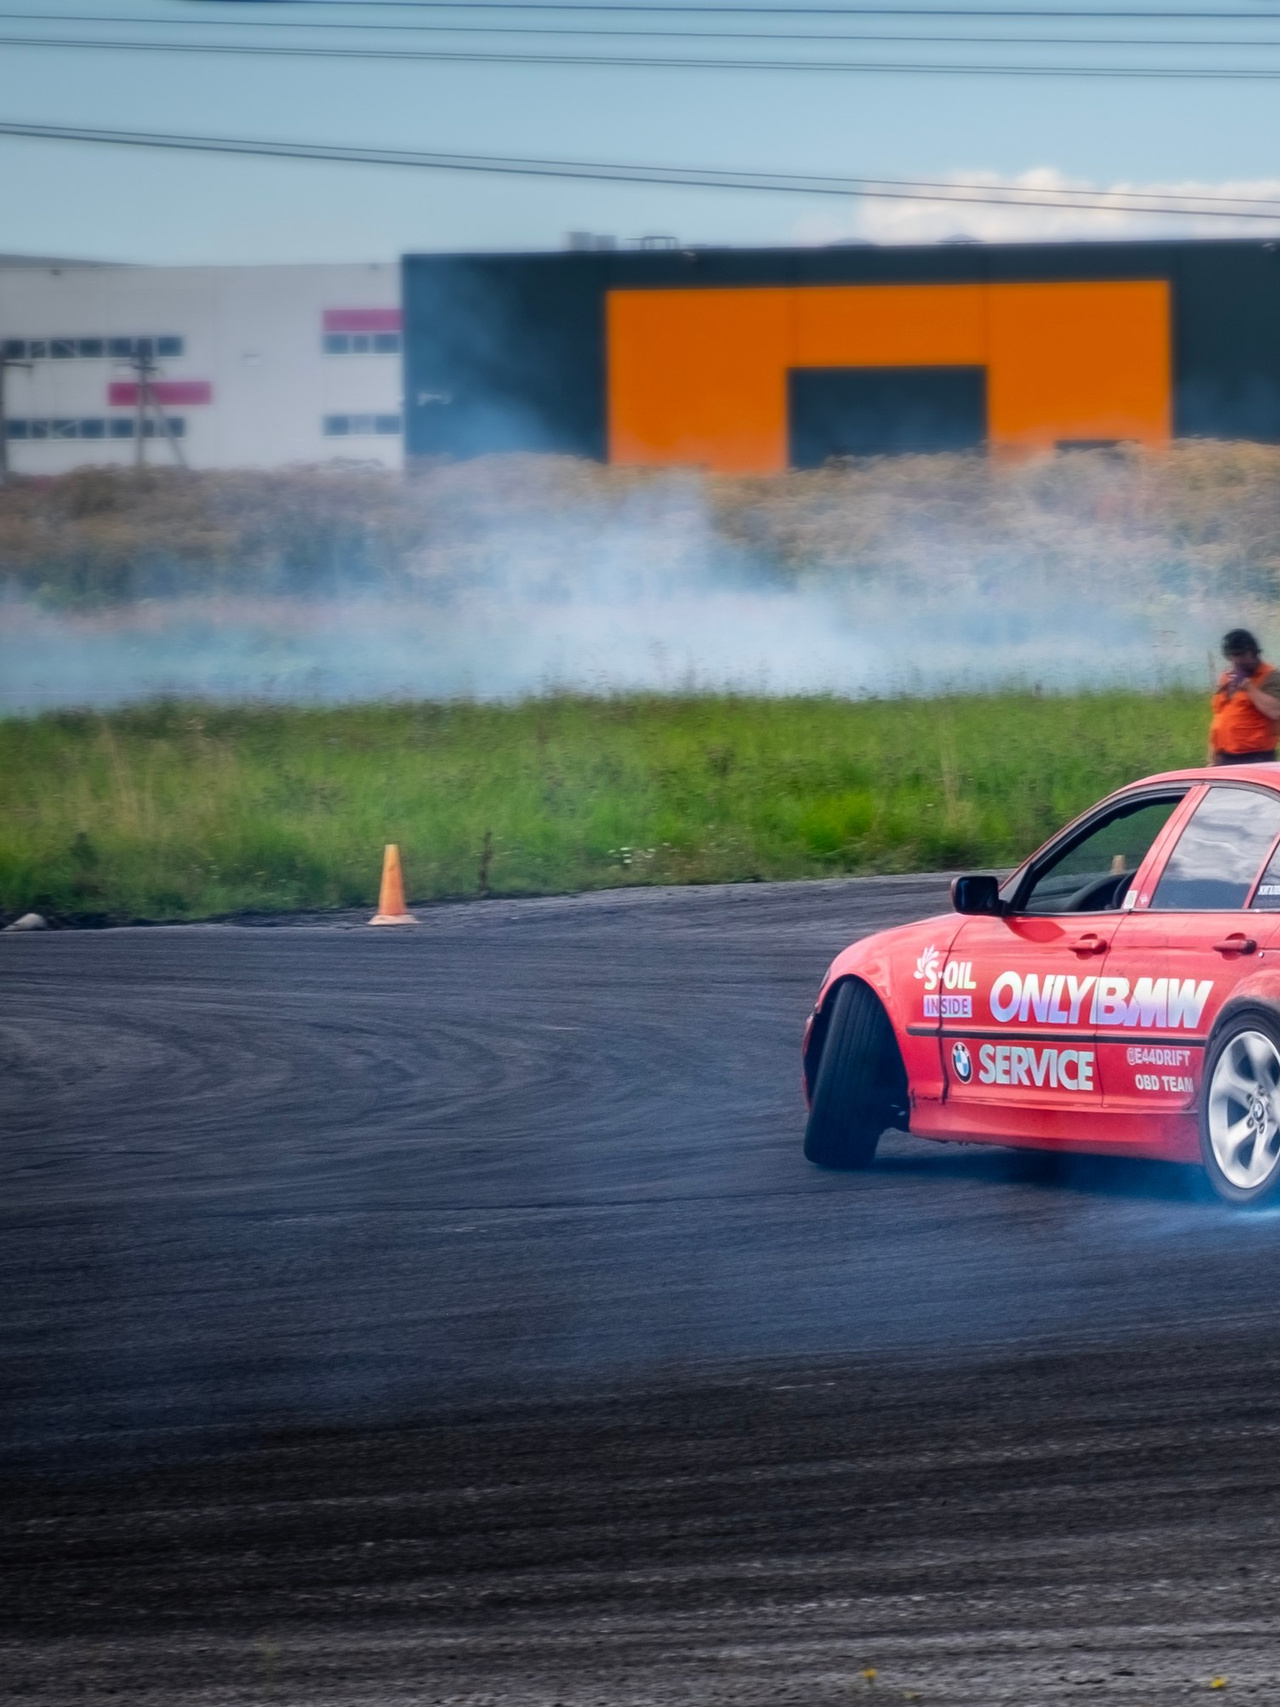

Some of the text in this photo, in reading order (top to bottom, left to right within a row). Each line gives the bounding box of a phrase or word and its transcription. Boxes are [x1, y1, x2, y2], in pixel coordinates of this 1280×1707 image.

[926, 997, 969, 1015] INSIDE
[990, 970, 1214, 1028] ONLYBMW
[1126, 1048, 1190, 1066] @E44DRIFT
[979, 1044, 1095, 1091] SERVICE
[1135, 1074, 1194, 1093] OBD TEAM
